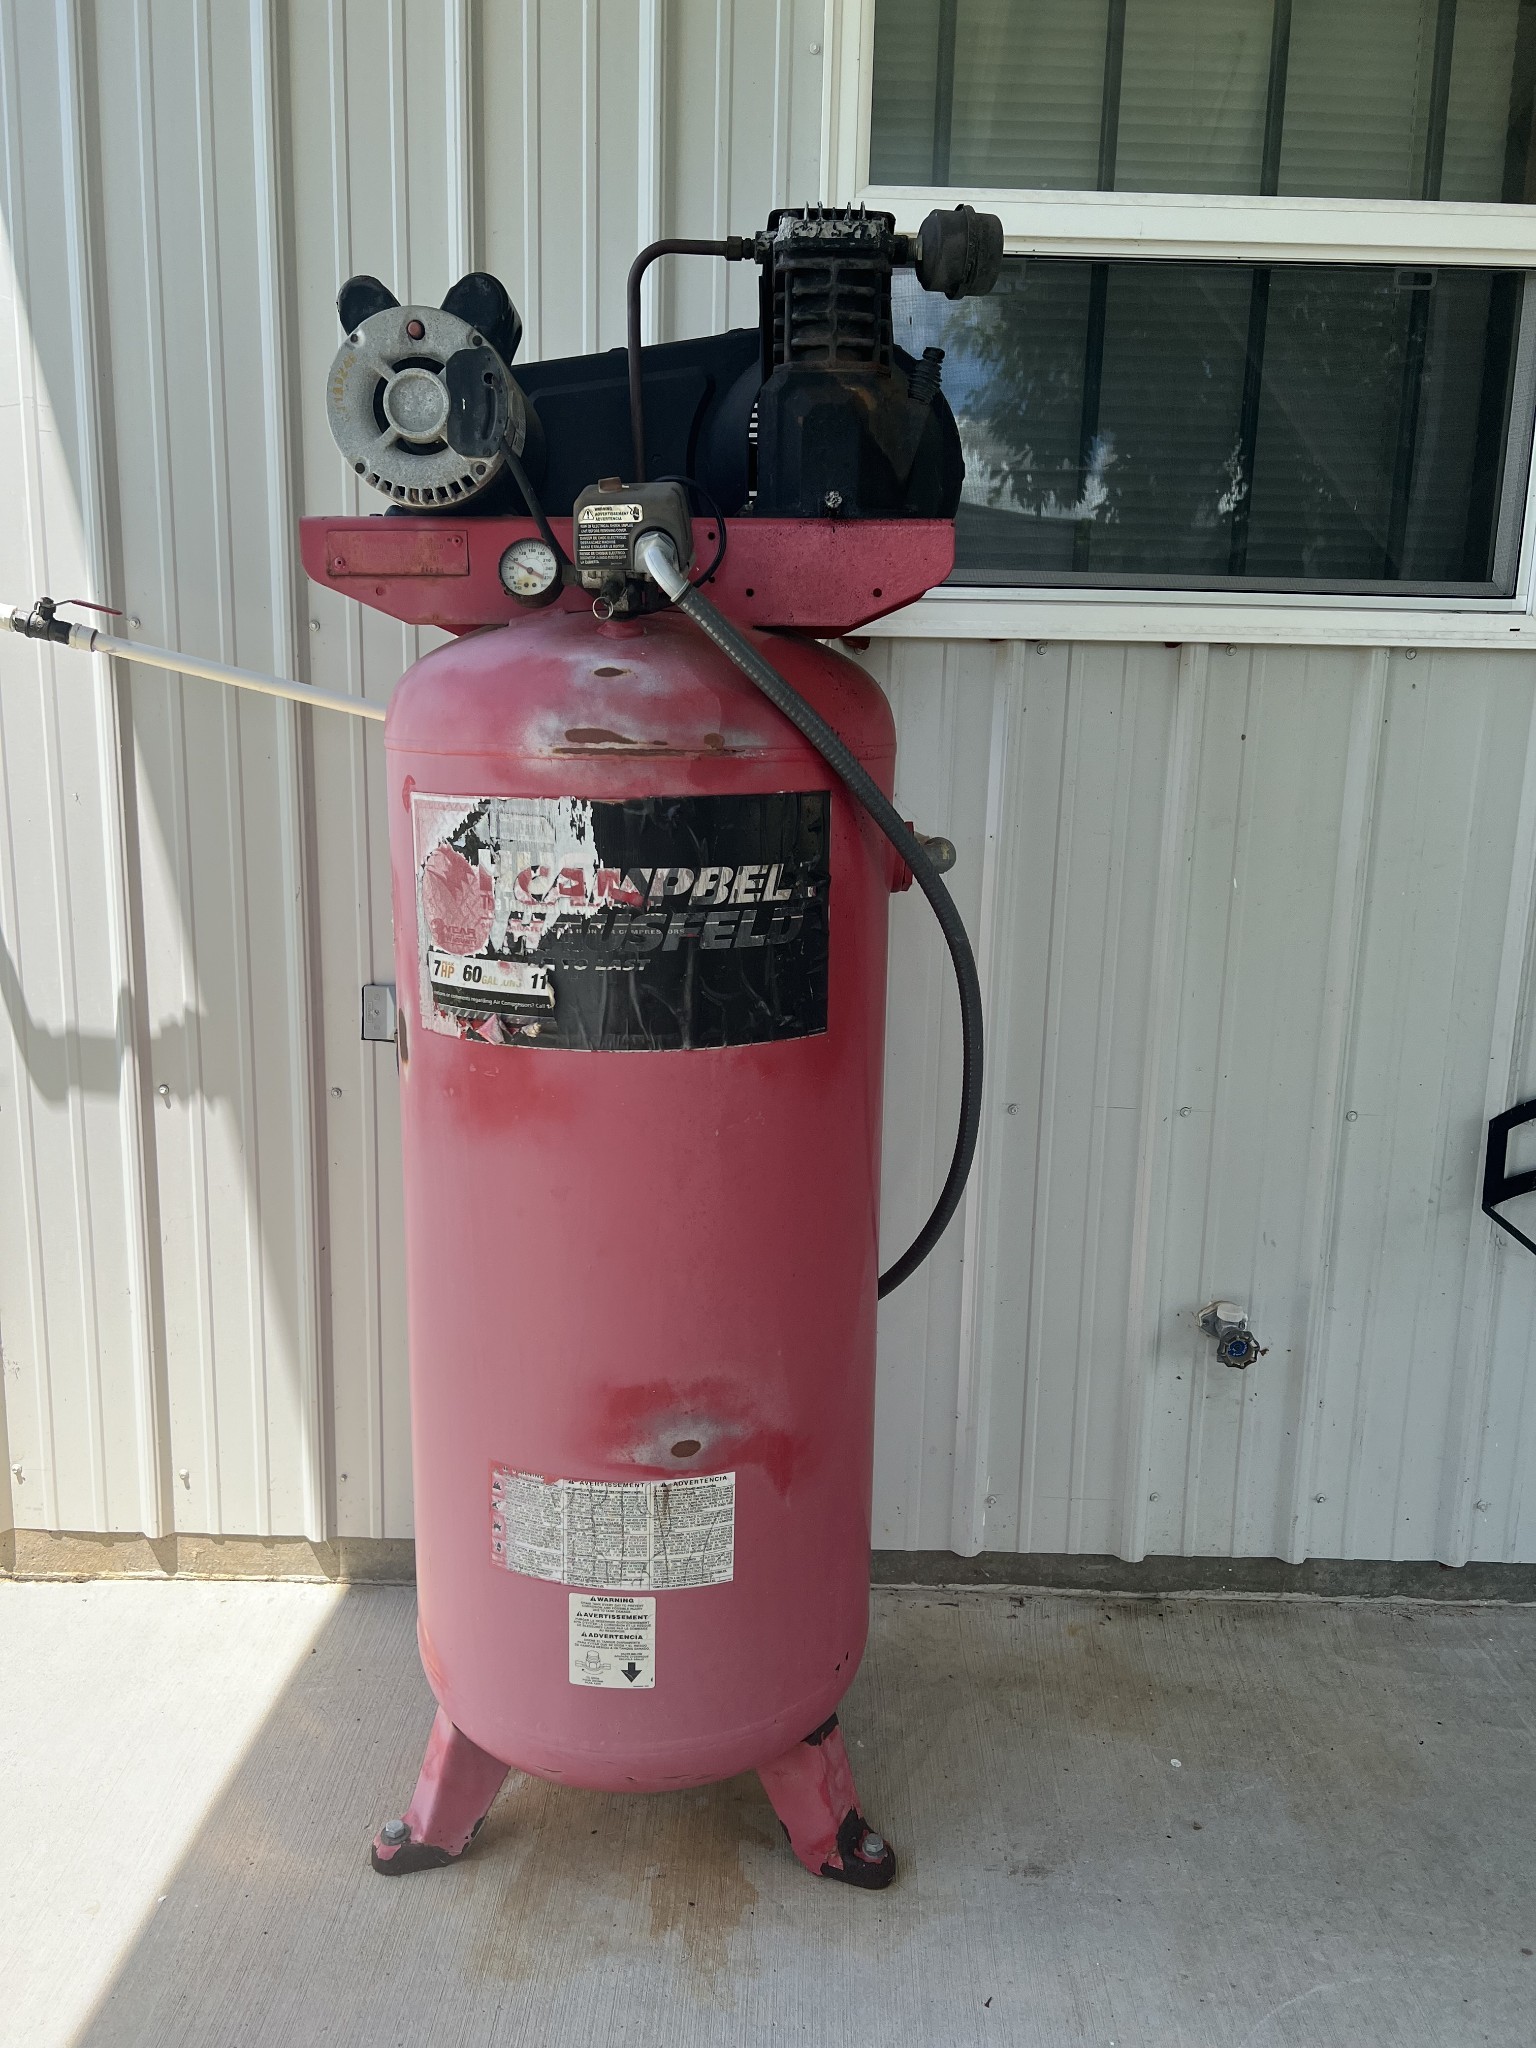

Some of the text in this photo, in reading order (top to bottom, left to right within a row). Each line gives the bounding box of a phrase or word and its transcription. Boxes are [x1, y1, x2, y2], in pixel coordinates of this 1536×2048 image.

[513, 864, 816, 908] CAMPBEL
[502, 907, 804, 953] HUSFELD
[433, 960, 441, 976] 7
[441, 964, 455, 978] HP
[463, 964, 483, 983] 60
[482, 975, 522, 987] GALONS
[673, 1475, 727, 1486] ADVERTENCIA
[584, 1612, 648, 1620] AVERTISSEMENT
[588, 1632, 643, 1640] ADVERTENCIA
